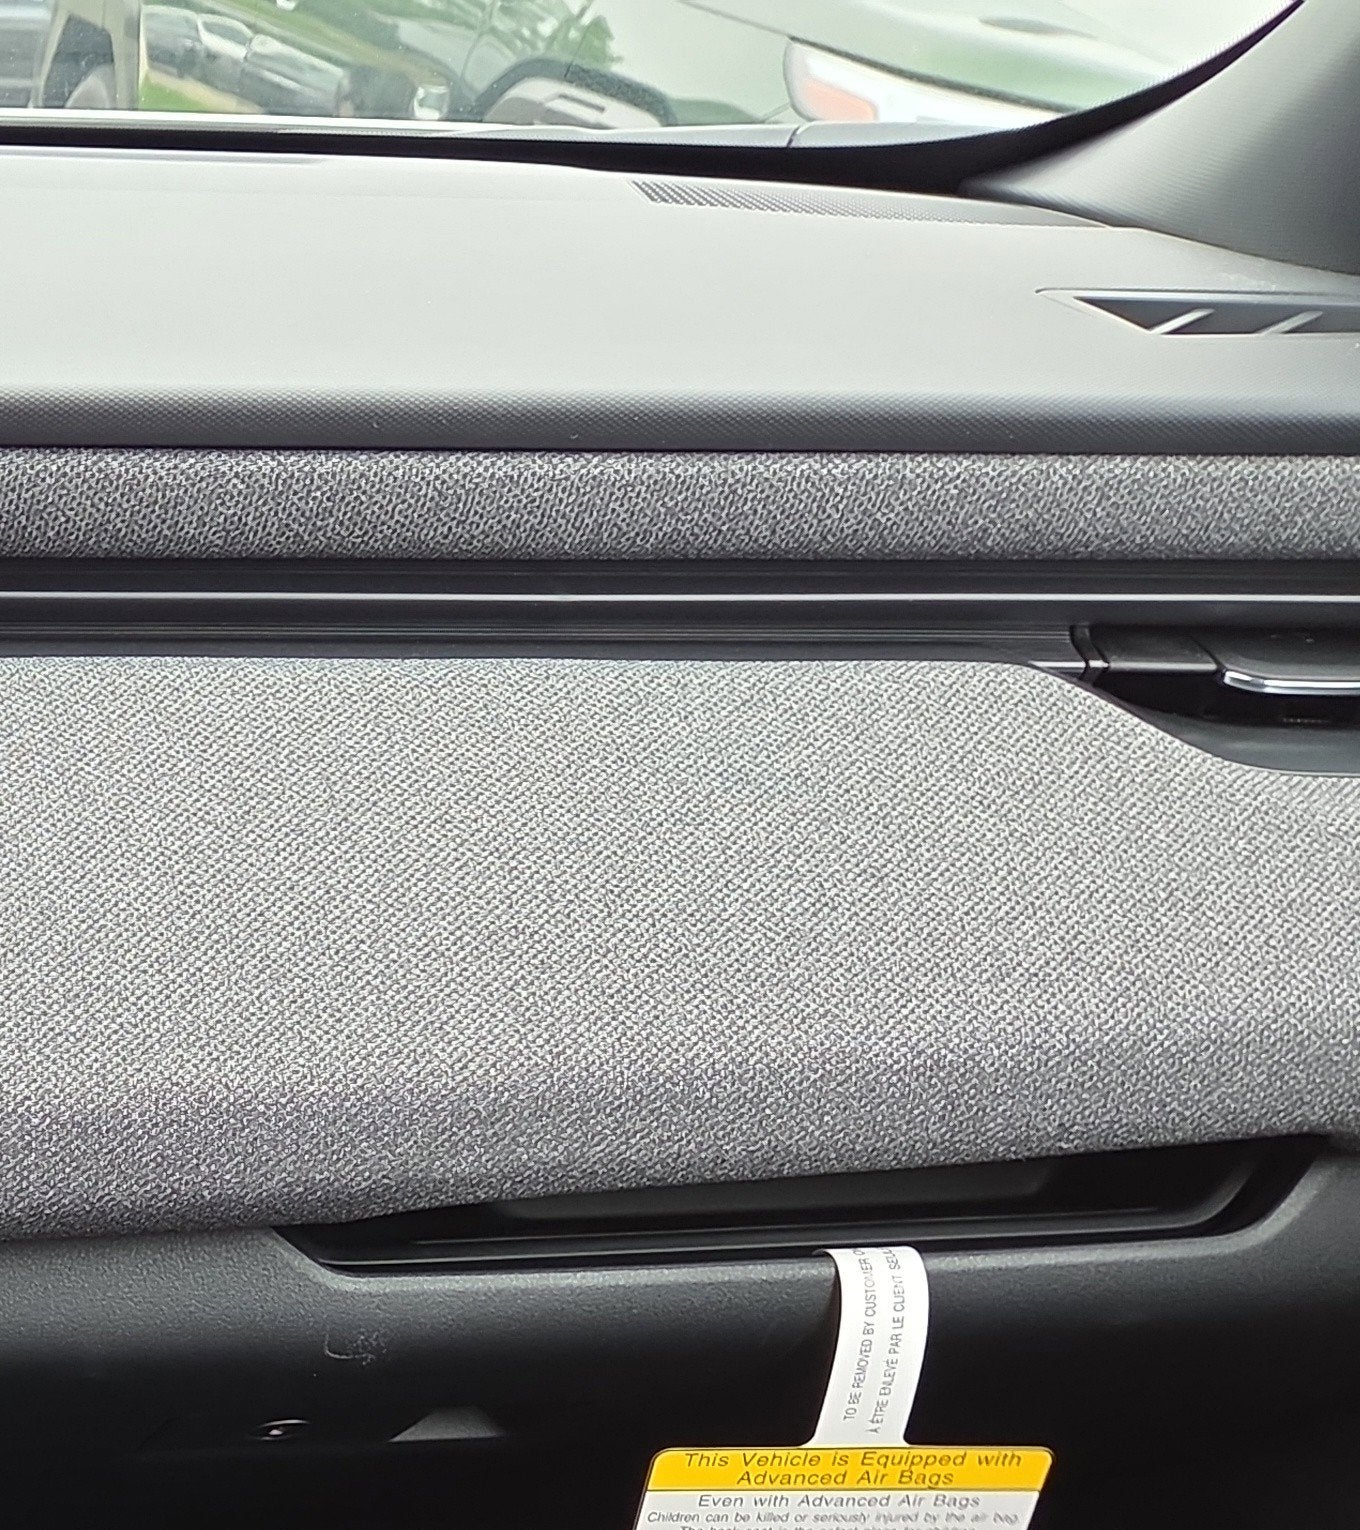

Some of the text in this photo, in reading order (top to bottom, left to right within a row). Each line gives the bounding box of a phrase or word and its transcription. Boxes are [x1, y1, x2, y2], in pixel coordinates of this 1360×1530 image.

[892, 1316, 905, 1329] LE
[889, 1333, 903, 1355] PAR
[843, 1408, 857, 1421] TO
[862, 1321, 875, 1335] BY
[685, 1451, 1022, 1469] This Vehicle is Equipped with
[737, 1470, 954, 1489] Advanced Air Bags
[699, 1494, 980, 1510] Even with Advanced Air Bags
[647, 1511, 700, 1523] Children
[706, 1513, 729, 1523] can
[735, 1511, 750, 1523] be
[756, 1511, 790, 1523] killed
[794, 1513, 808, 1522] or
[945, 1511, 966, 1522] the
